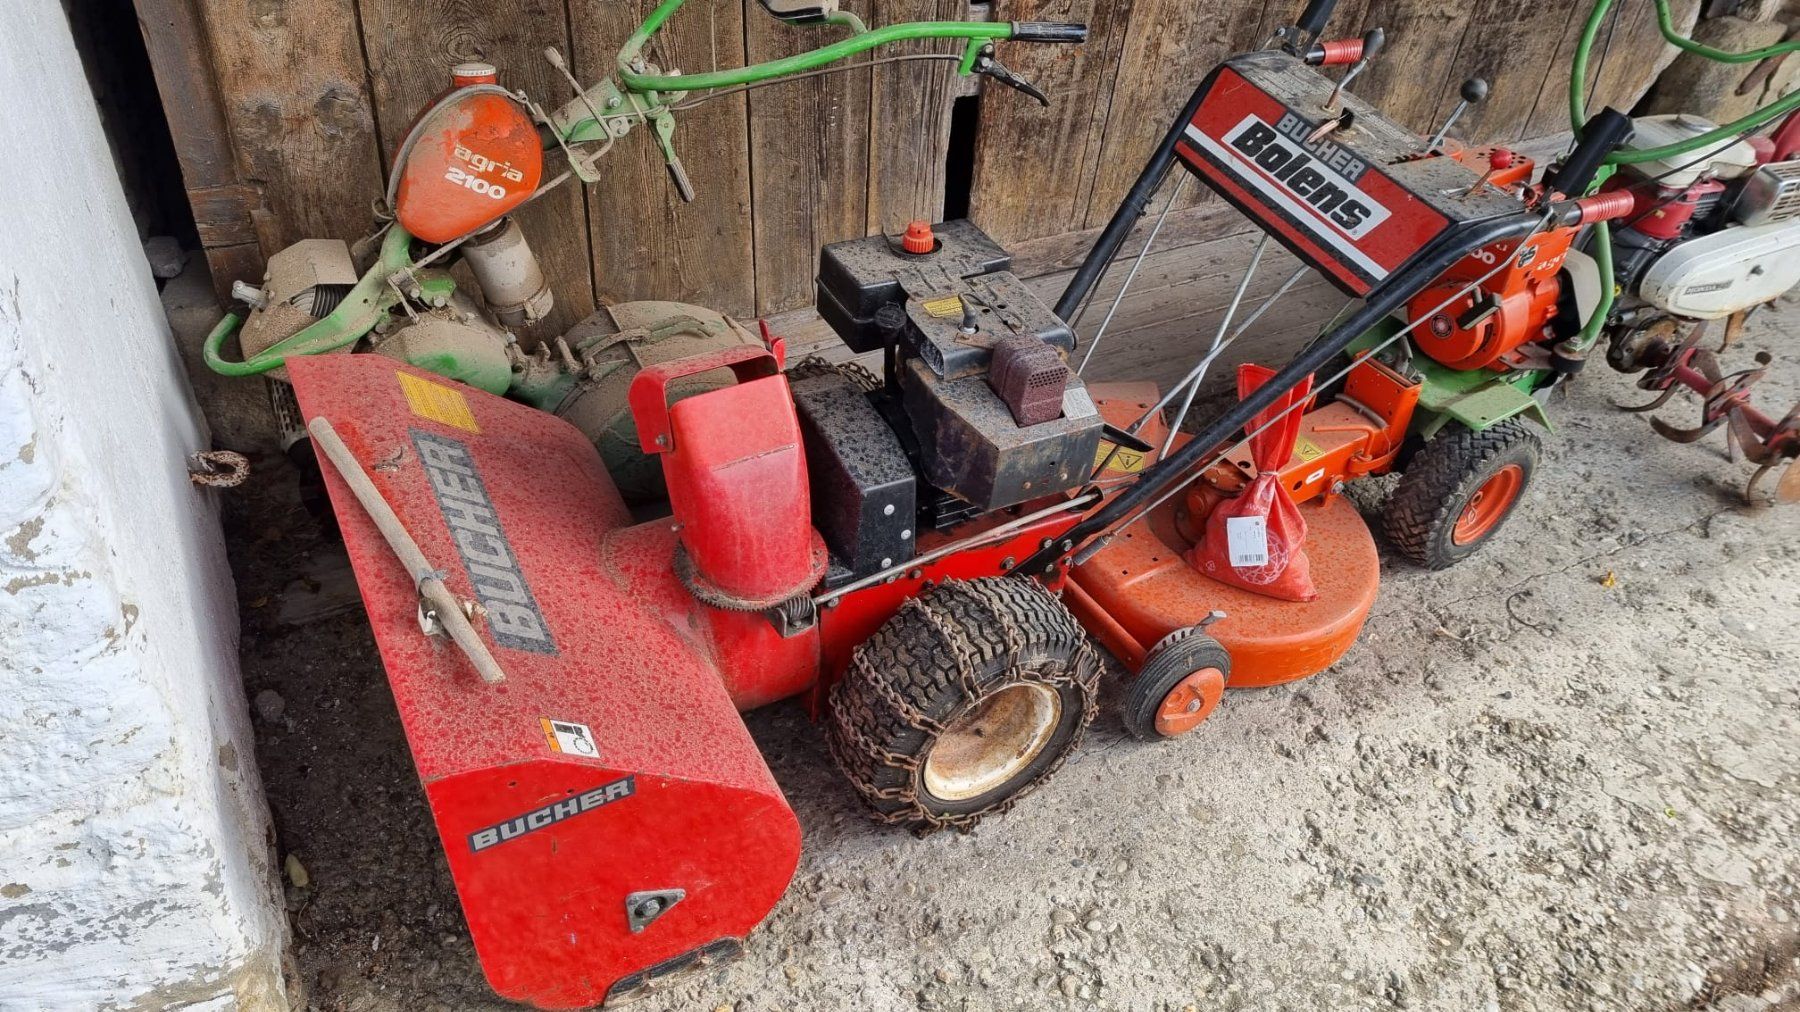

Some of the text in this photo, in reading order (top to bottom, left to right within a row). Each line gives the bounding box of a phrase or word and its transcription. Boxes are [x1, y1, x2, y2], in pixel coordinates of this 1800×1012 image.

[445, 167, 506, 199] 2100
[455, 144, 523, 182] agria
[1233, 124, 1371, 230] Bolens
[416, 440, 544, 640] BUCHER
[472, 779, 630, 852] BUCHER
